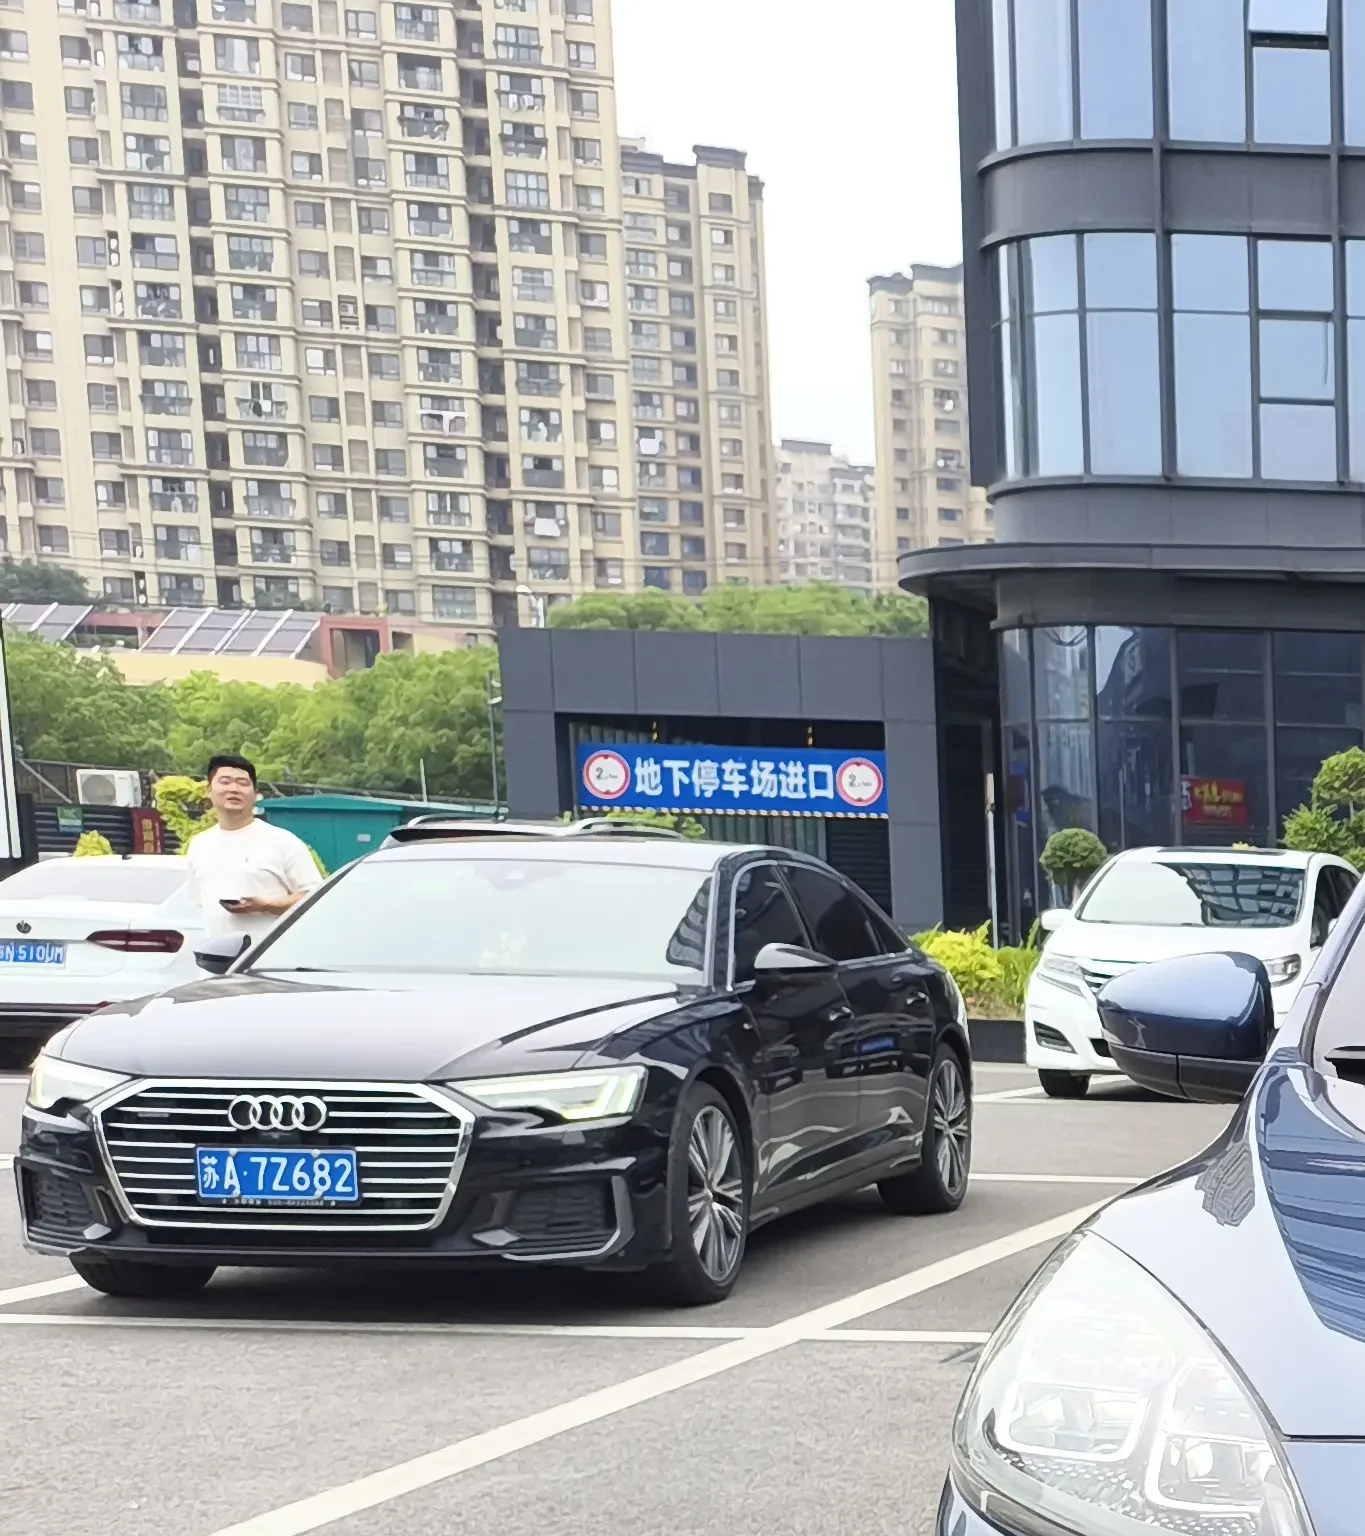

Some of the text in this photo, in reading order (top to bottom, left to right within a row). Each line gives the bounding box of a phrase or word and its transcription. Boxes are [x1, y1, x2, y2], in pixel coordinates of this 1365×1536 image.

[634, 756, 835, 800] 地下停车场进口
